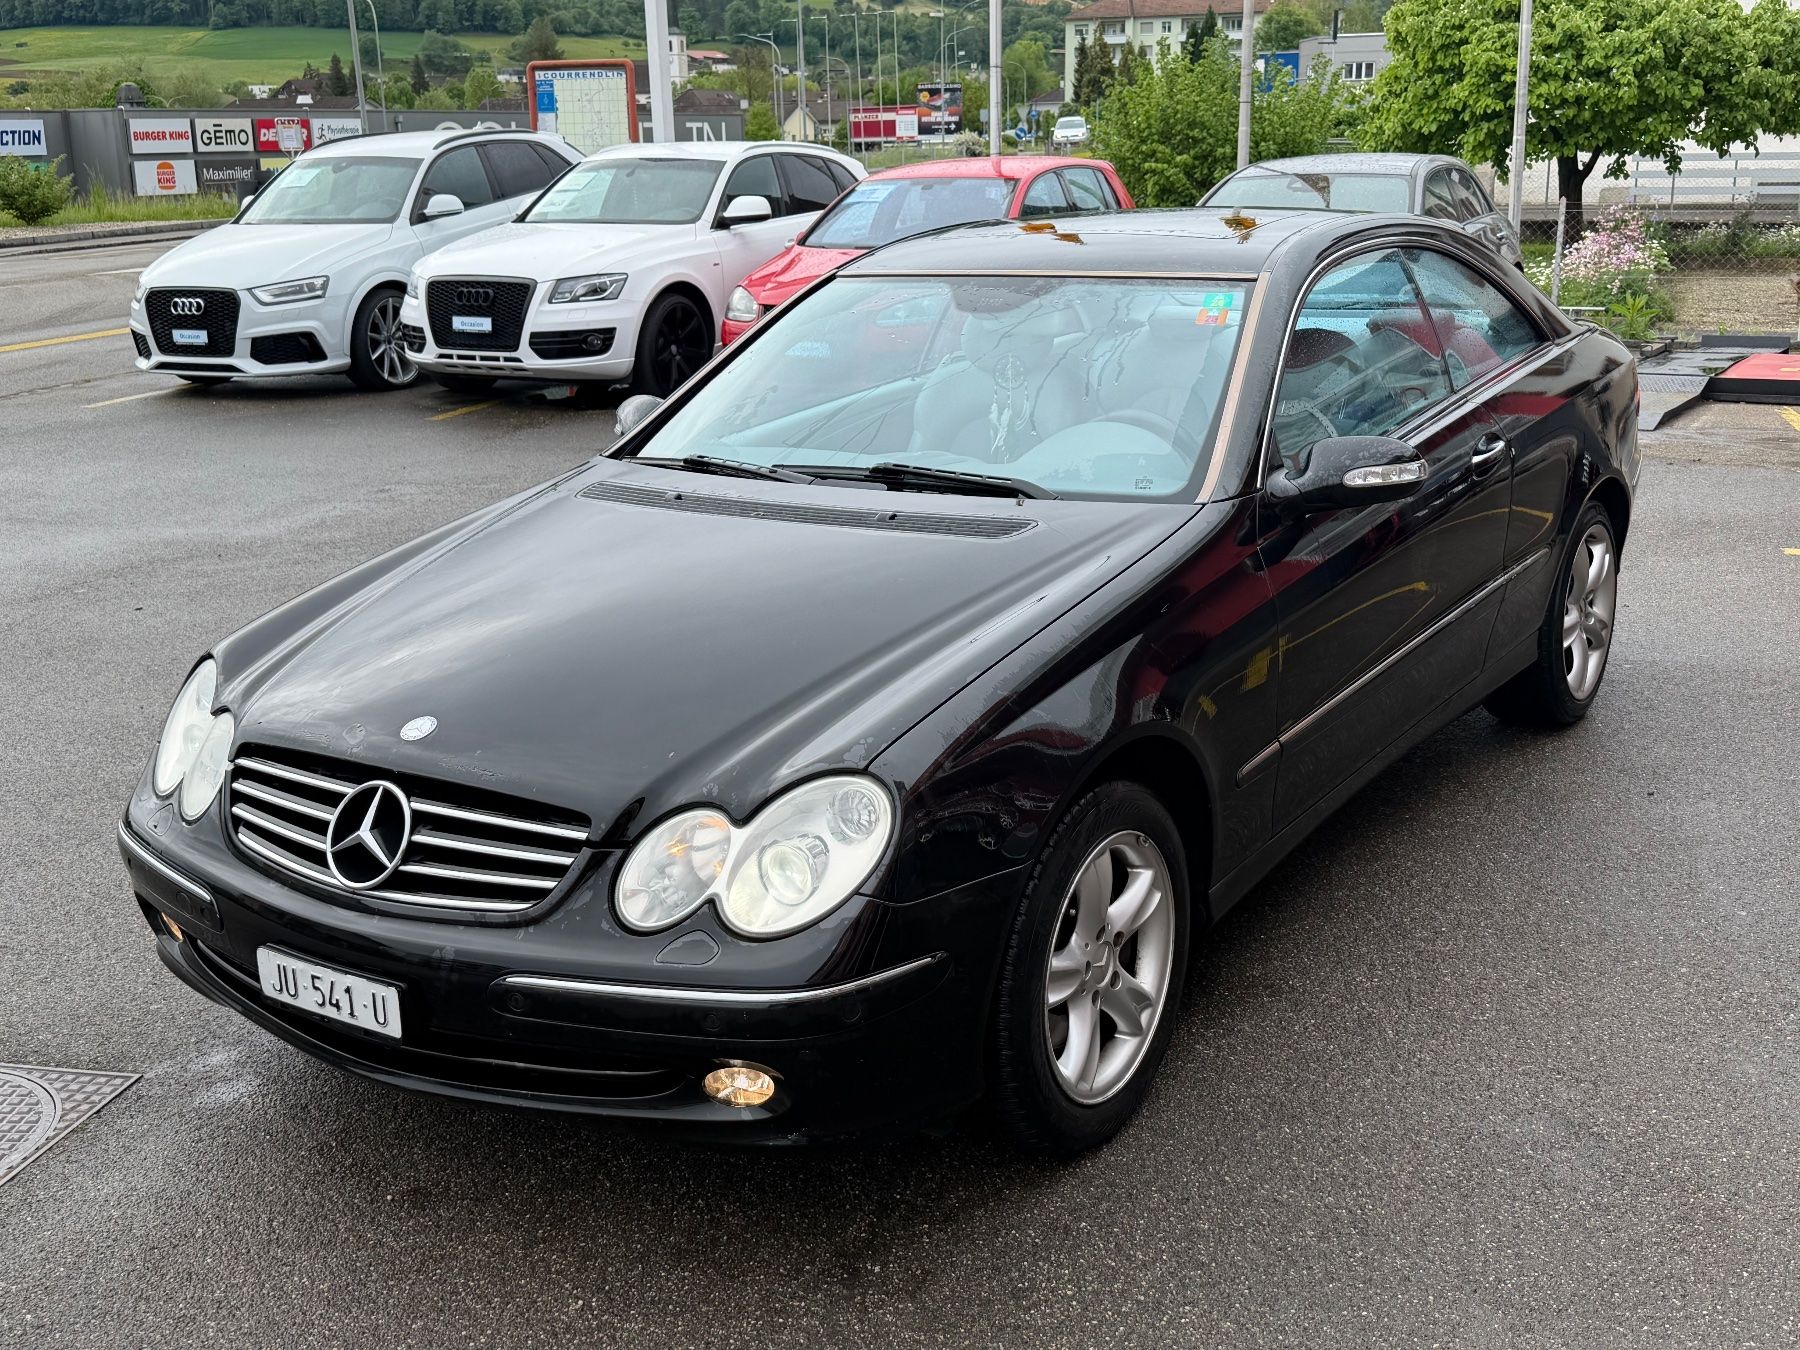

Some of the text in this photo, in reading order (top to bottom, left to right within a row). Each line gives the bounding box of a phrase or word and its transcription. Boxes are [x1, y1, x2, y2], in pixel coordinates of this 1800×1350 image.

[133, 130, 190, 141] BURGER KING
[260, 128, 308, 142] DER
[157, 176, 176, 185] KING
